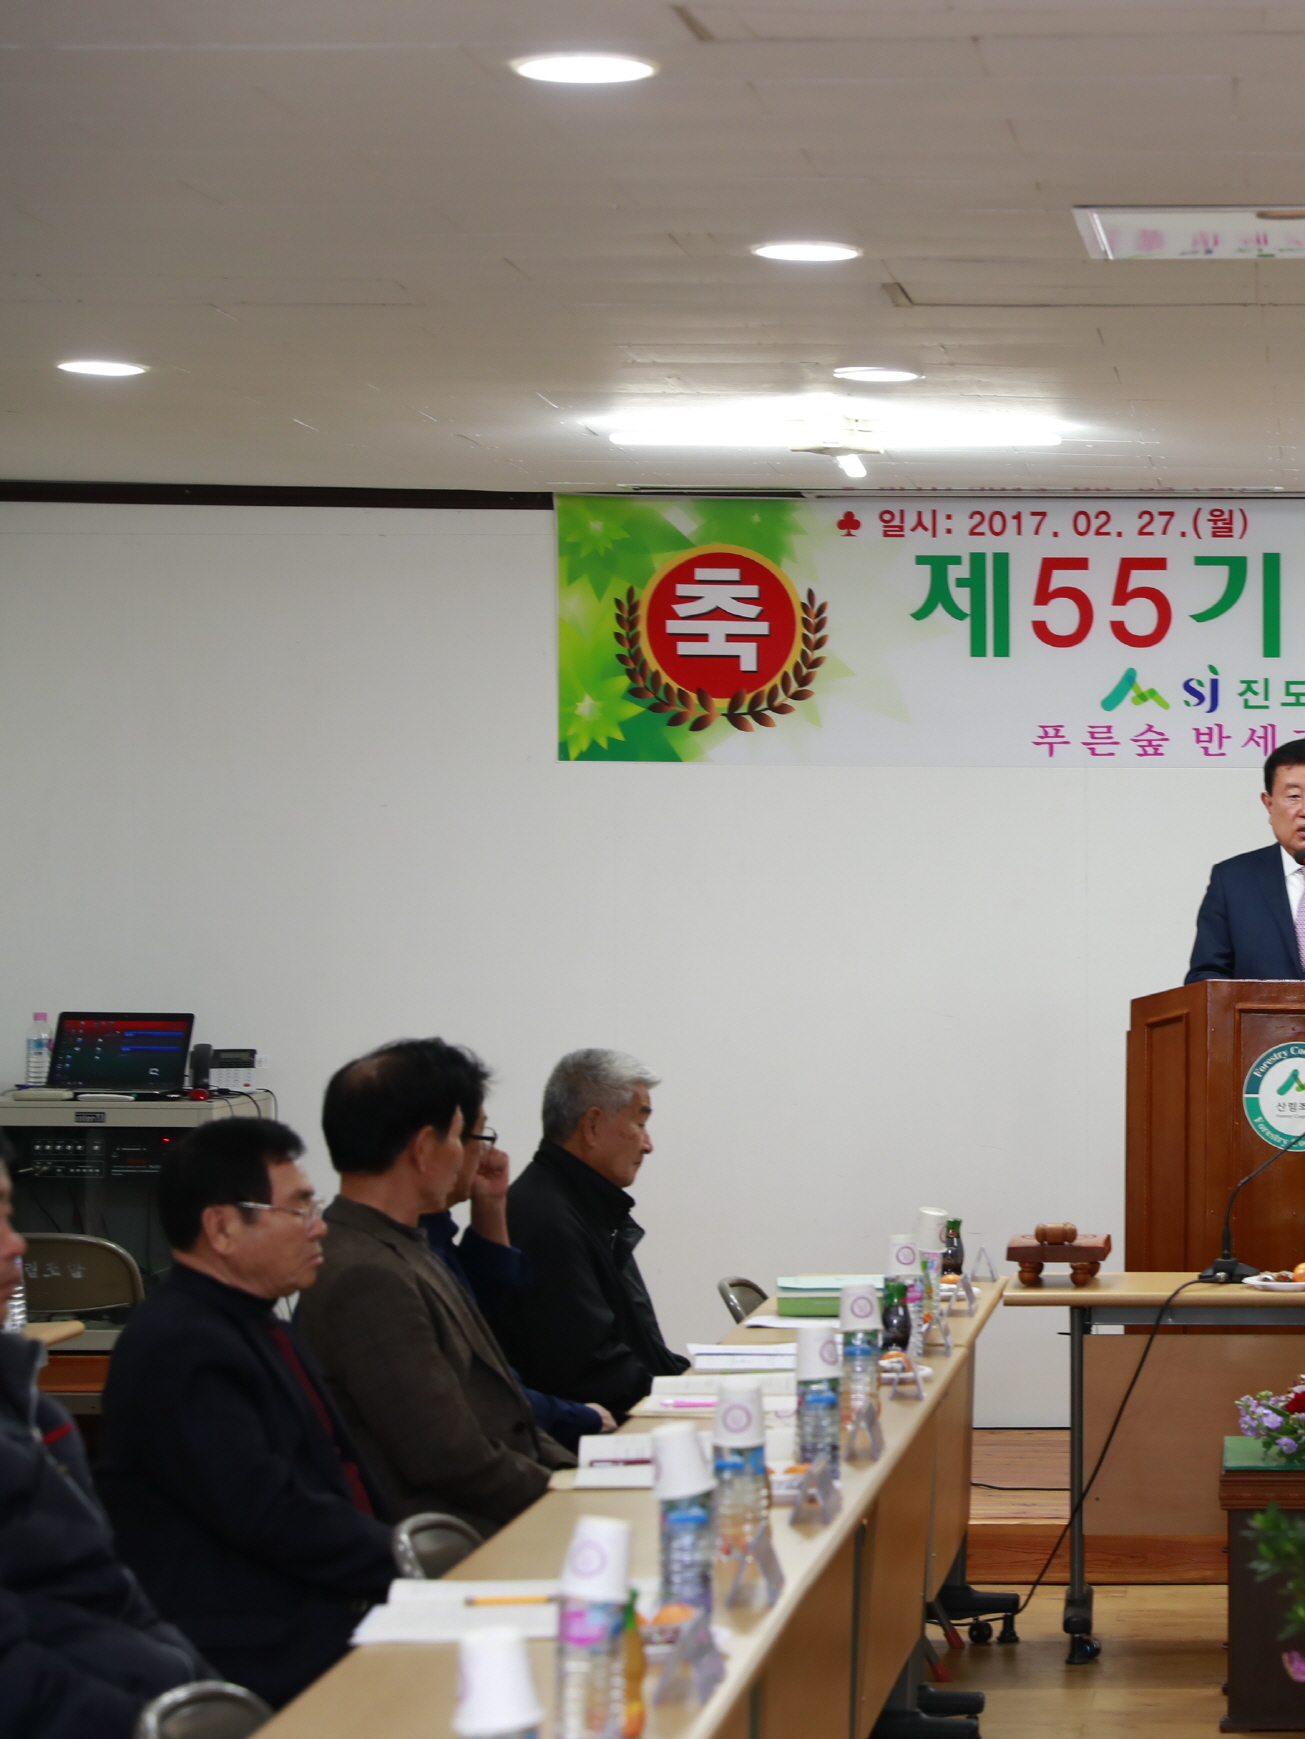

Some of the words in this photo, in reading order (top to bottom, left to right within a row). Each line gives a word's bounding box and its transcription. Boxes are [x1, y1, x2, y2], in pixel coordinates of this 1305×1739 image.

[879, 509, 952, 538] 일시:
[969, 511, 1058, 537] 2017.
[1073, 510, 1122, 537] 02.
[665, 566, 771, 673] 축
[910, 552, 1281, 658] 제55기
[1032, 724, 1169, 757] 푸른숲
[1253, 1049, 1289, 1078] Forestry
